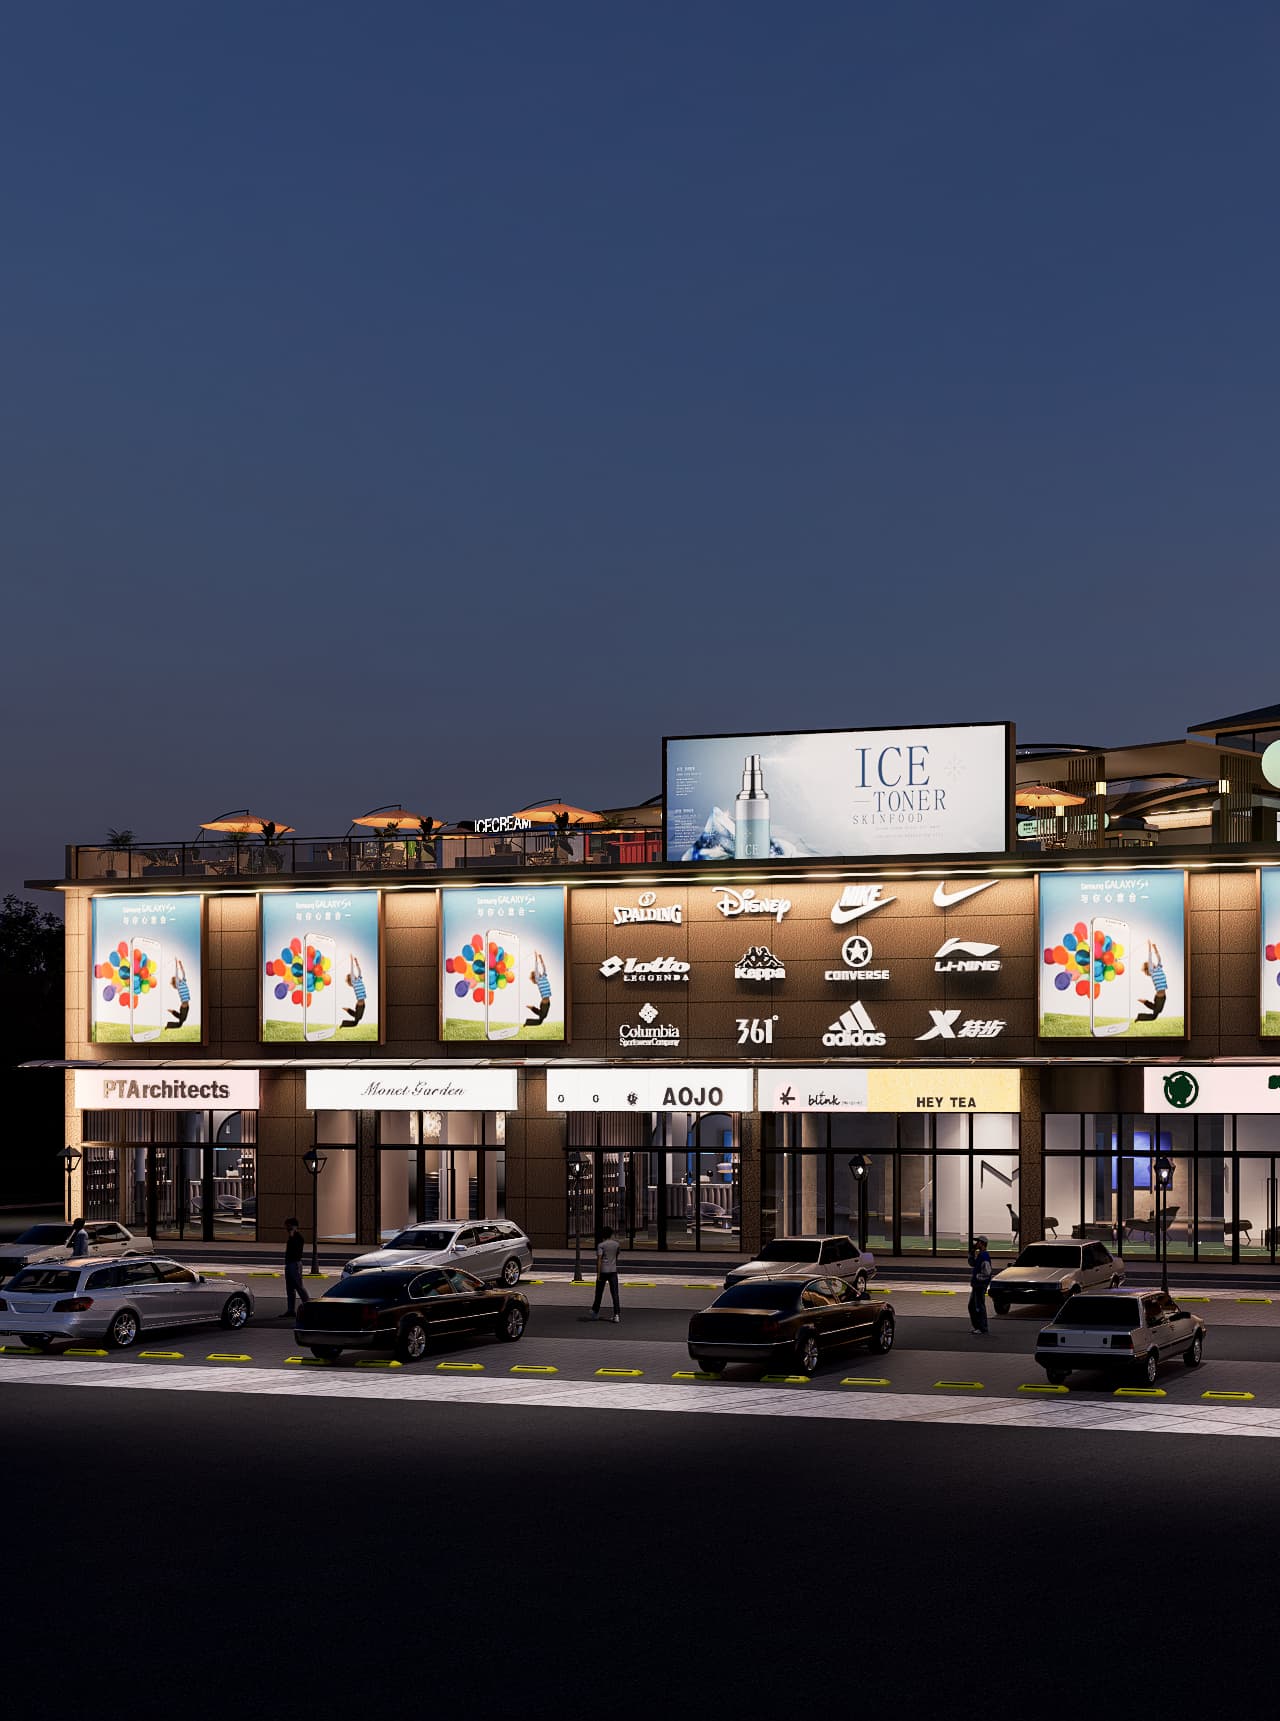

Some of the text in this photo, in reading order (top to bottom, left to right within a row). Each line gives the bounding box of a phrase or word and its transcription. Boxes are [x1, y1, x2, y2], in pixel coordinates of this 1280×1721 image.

[855, 745, 930, 788] ICE
[873, 789, 946, 812] TONER
[852, 813, 923, 825] SKINFOOD
[1105, 879, 1136, 889] GALAXY
[839, 884, 884, 907] NIKE
[613, 904, 682, 925] SPALDING
[623, 974, 690, 982] LEGGENDA
[824, 969, 891, 981] CONVERSE
[618, 1024, 681, 1038] Columbia
[821, 1028, 887, 1047] adidas
[103, 1079, 230, 1099] PTArchitects
[360, 1080, 465, 1096] Monet Garden
[662, 1086, 724, 1106] AOJO
[916, 1096, 977, 1108] HEY TEA
